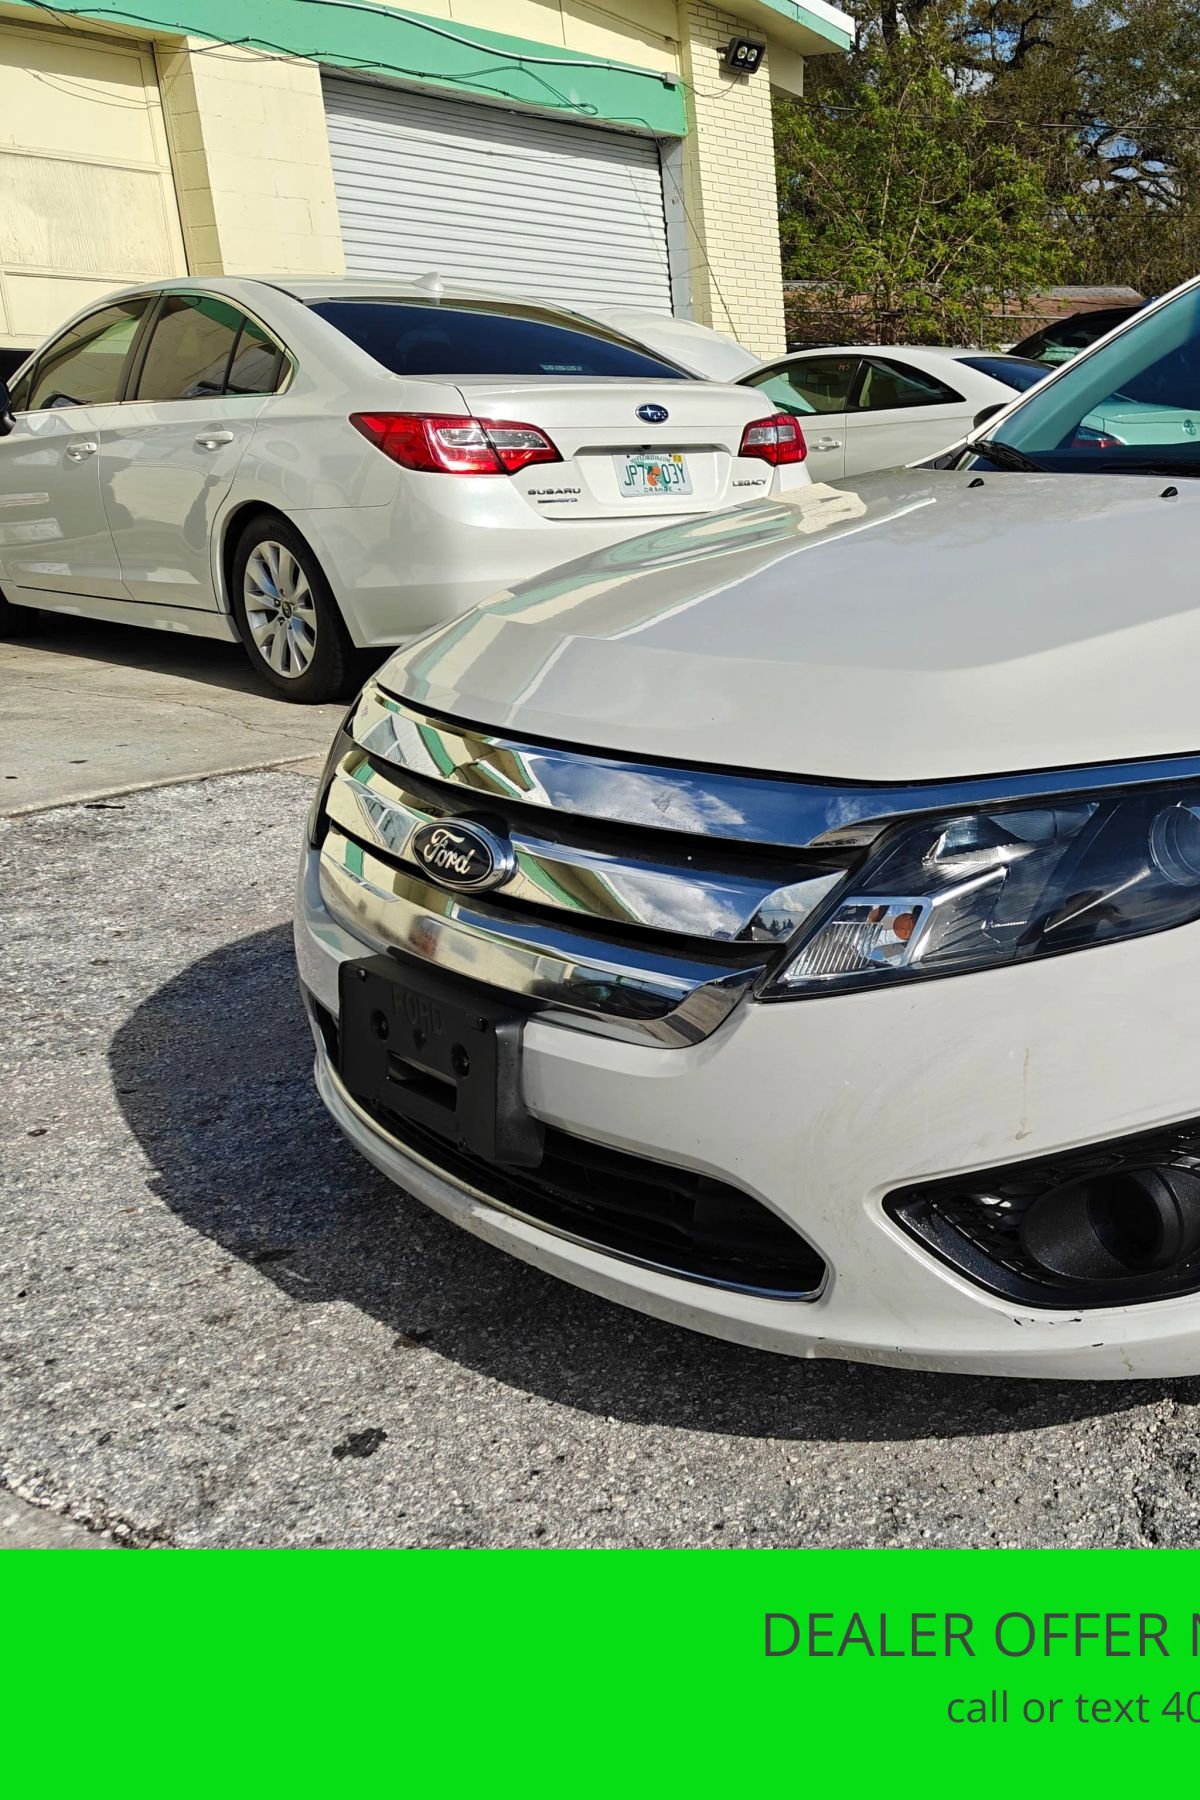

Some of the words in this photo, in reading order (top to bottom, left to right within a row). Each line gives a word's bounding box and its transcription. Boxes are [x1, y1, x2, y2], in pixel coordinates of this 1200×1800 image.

[731, 478, 767, 487] LEGACY
[527, 487, 582, 496] SUBARU
[423, 828, 476, 875] Ford
